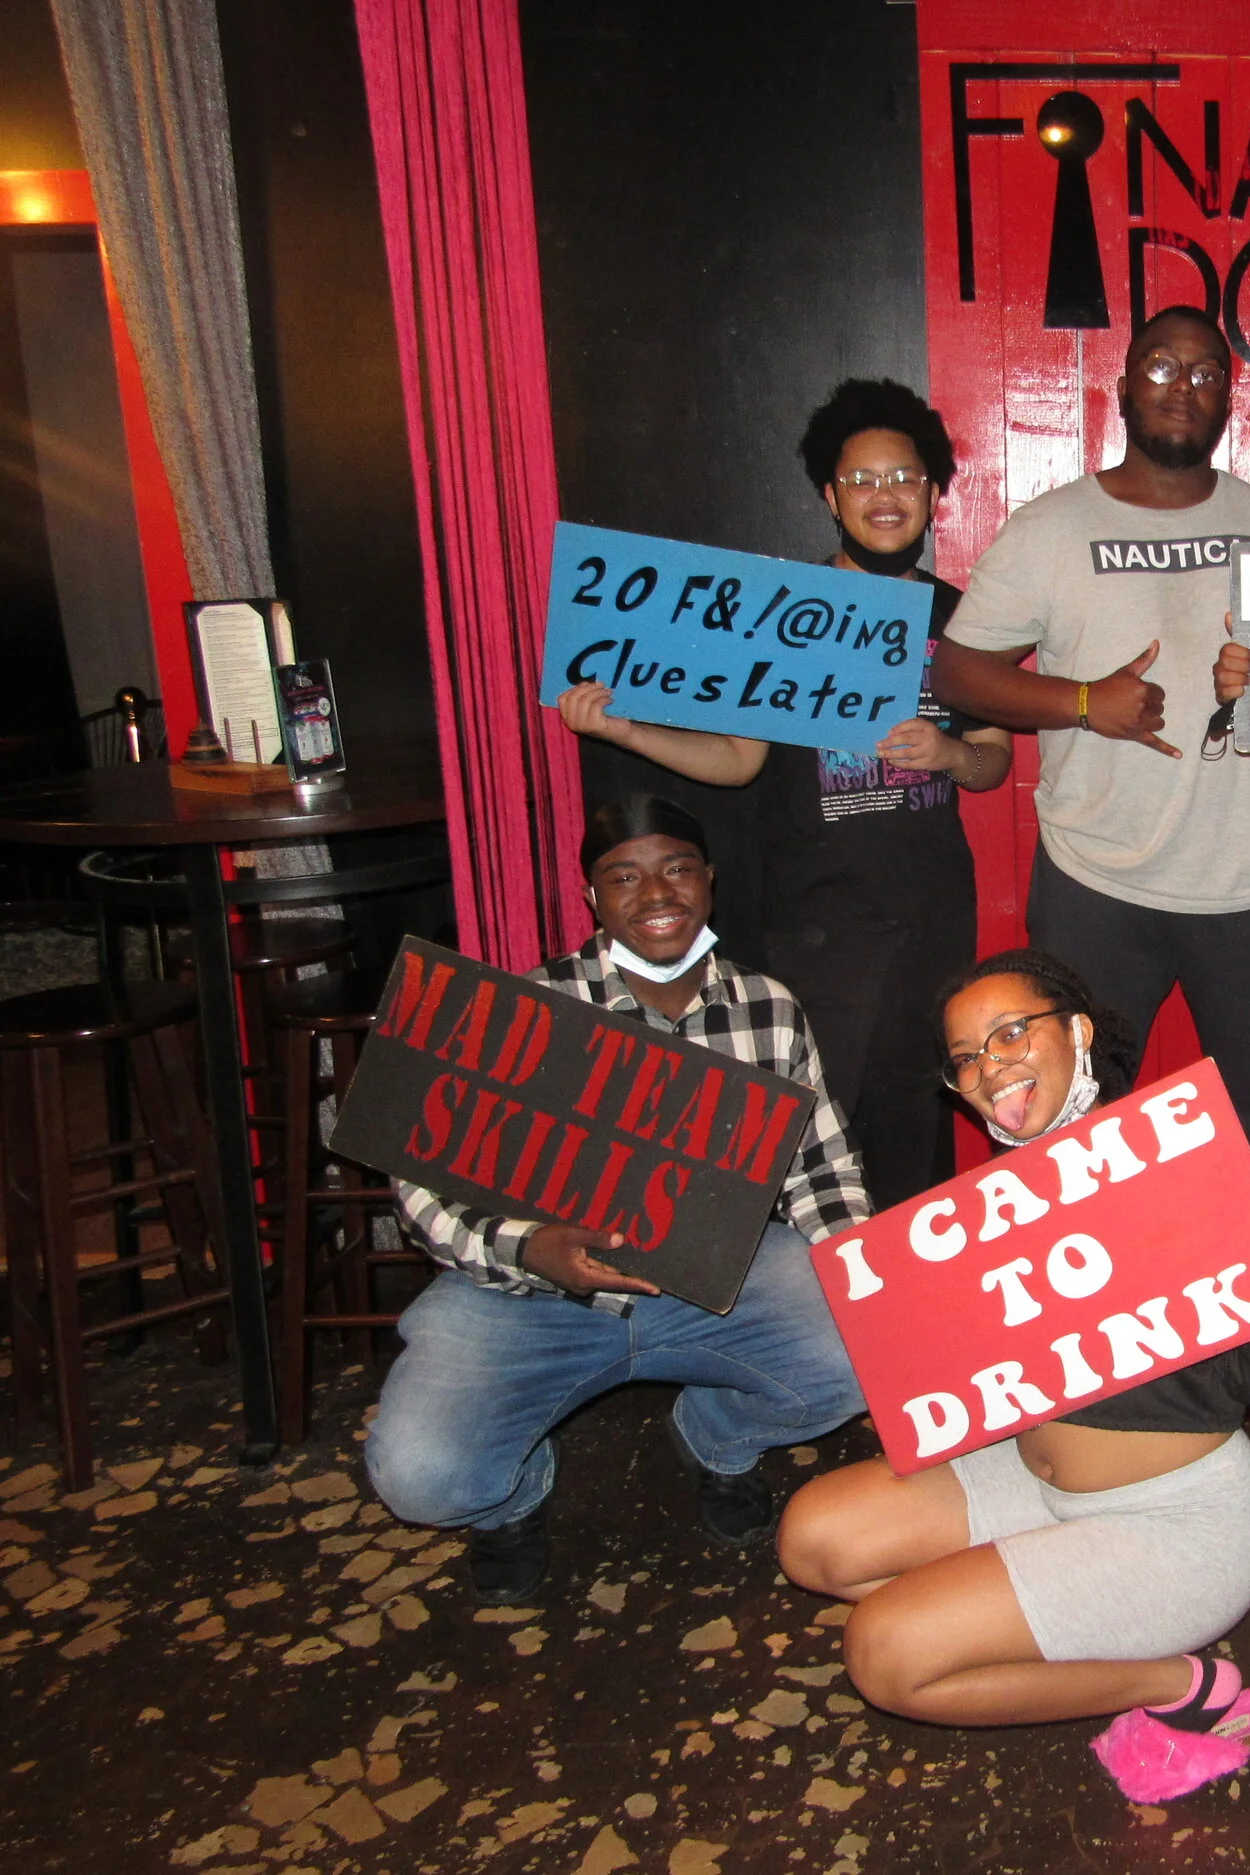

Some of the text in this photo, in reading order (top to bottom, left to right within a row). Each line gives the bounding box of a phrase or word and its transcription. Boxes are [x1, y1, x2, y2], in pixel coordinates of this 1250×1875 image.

[572, 556, 659, 613] 20
[1098, 539, 1240, 570] NAUTIC
[376, 951, 800, 1185] MAD TEAM
[404, 1072, 691, 1253] SKILLS
[835, 1081, 1216, 1301] I CAME
[981, 1233, 1113, 1328] TO
